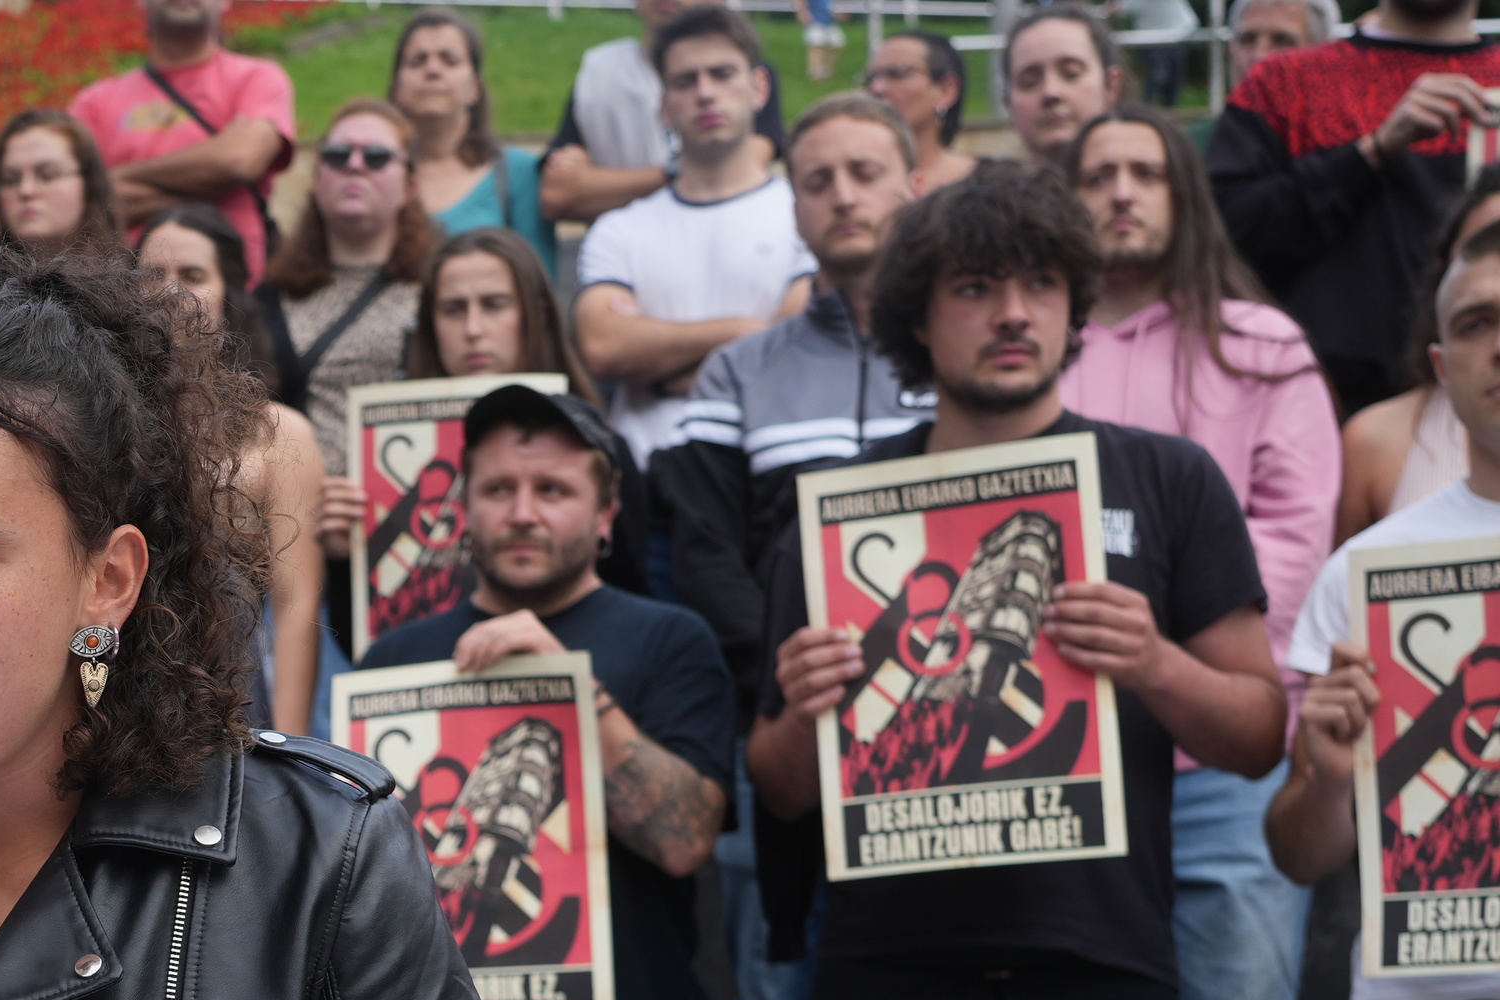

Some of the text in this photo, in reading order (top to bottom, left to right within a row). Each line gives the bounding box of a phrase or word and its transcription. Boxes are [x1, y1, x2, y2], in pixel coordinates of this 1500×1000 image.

[821, 463, 1076, 521] AURRERA EIBARKO GAZTETXIA
[1370, 561, 1500, 599] AURRERA EIBA
[864, 787, 1028, 834] DESALOJORIK
[859, 822, 1005, 866] ERANTZUNIK
[1407, 896, 1500, 932] DESALO
[1397, 928, 1500, 965] ERANTZU
